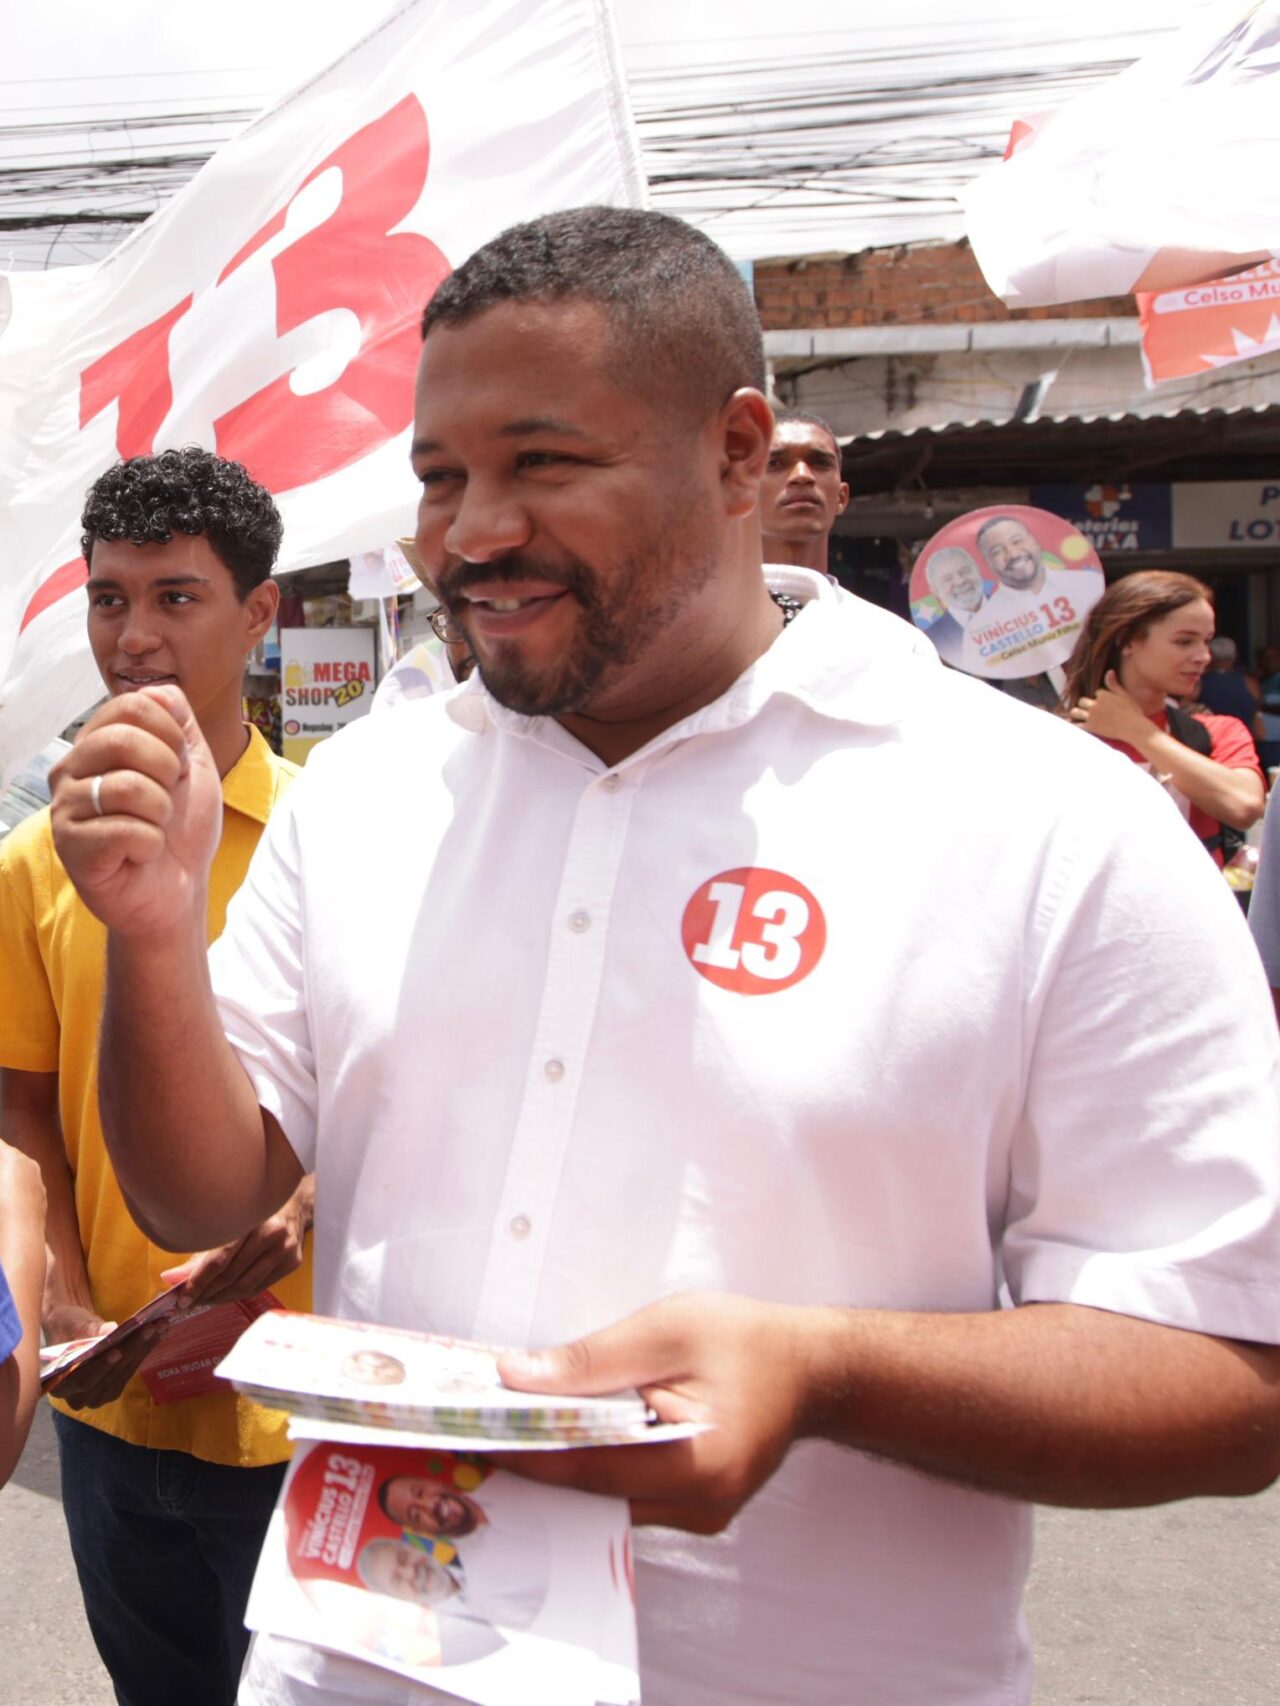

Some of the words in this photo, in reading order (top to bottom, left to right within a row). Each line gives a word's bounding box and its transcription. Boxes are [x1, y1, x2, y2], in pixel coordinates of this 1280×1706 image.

[1184, 288, 1242, 305] Celso
[1230, 518, 1280, 541] LO
[972, 610, 1038, 645] VINÍCIUS
[1040, 596, 1076, 629] 13
[980, 623, 1044, 657] CASTELLO
[313, 661, 372, 682] MEGA
[285, 687, 334, 706] SHOP
[335, 680, 364, 707] 20
[692, 881, 810, 980] 13
[324, 1453, 361, 1492] 13
